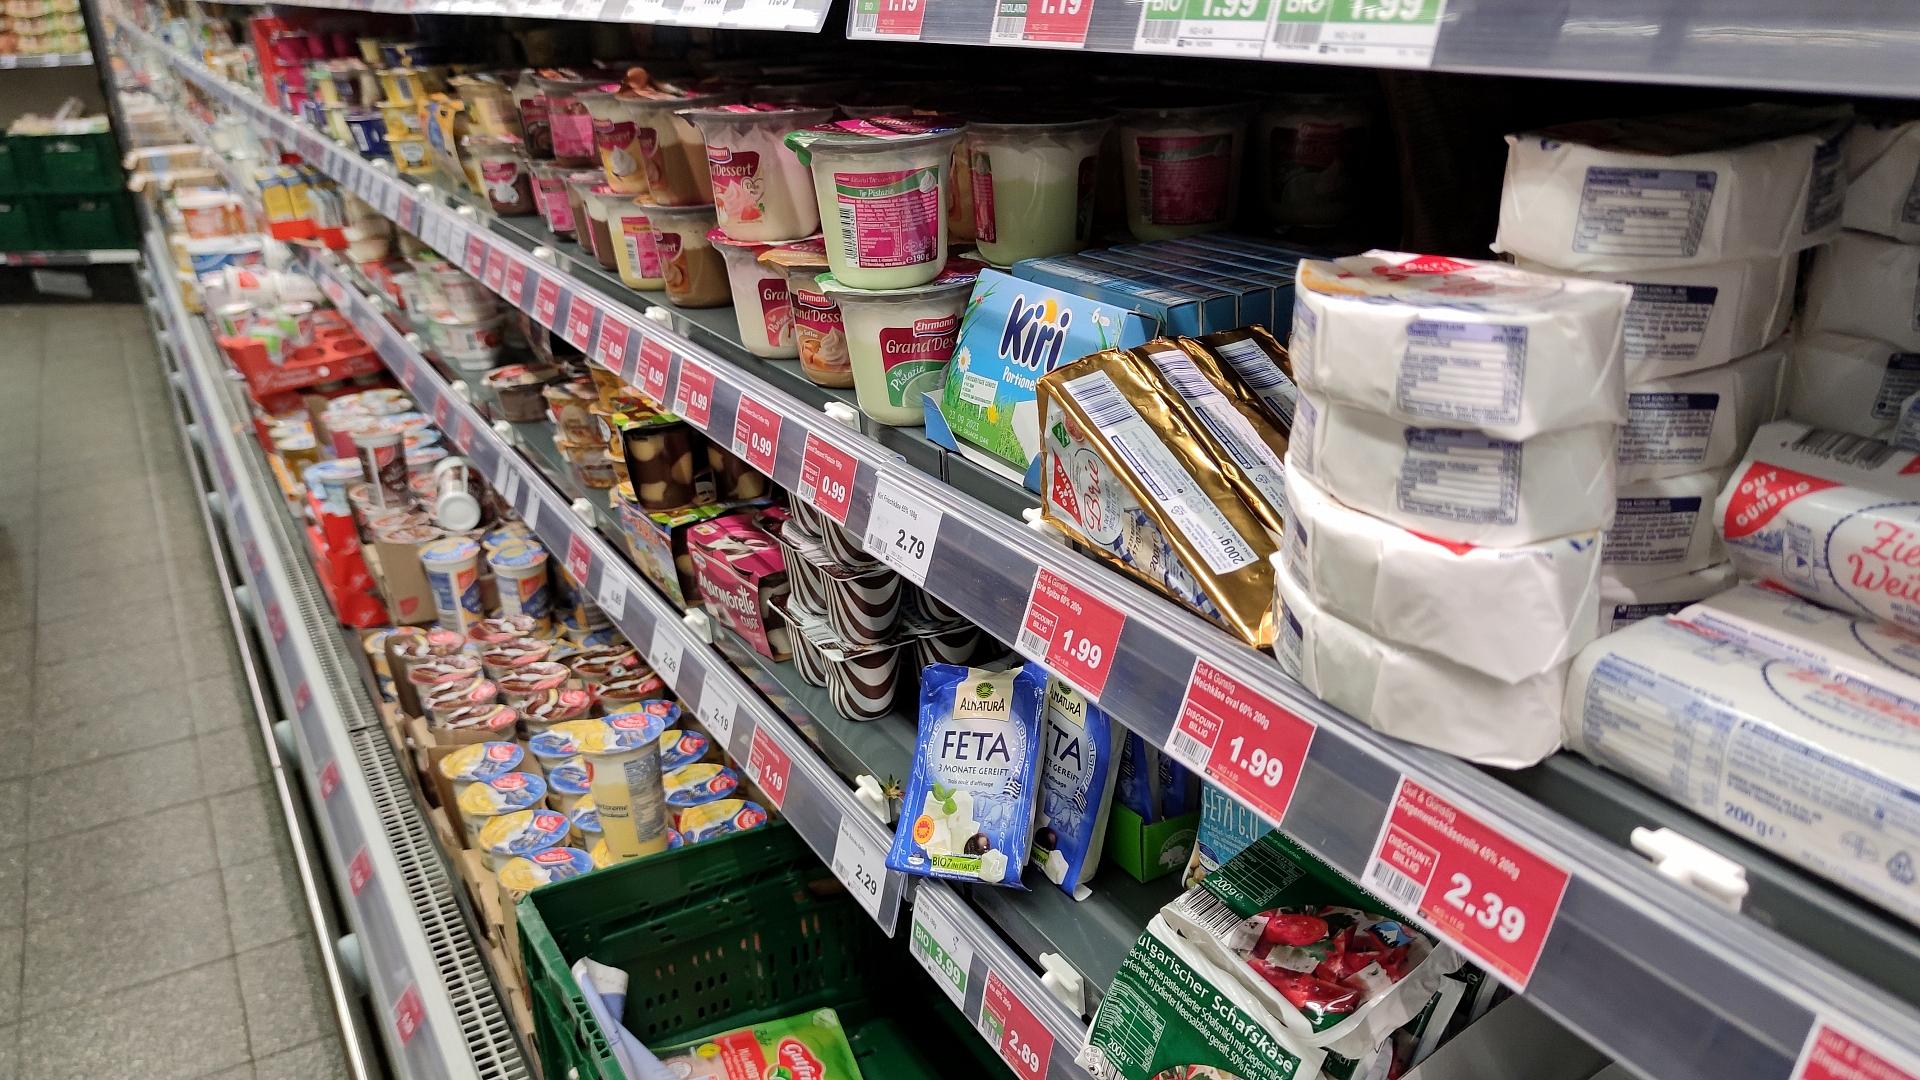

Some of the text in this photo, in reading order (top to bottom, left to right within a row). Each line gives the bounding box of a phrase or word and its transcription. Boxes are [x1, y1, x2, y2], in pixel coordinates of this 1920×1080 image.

[1000, 4, 1027, 13] BIOLAND
[800, 293, 830, 303] Ehrman
[916, 319, 954, 331] Ehrmann
[1092, 307, 1101, 323] 6
[886, 340, 930, 353] Grand
[1000, 296, 1071, 373] Kiri
[650, 367, 664, 387] 0.99
[891, 365, 926, 392] Pistazie
[691, 390, 707, 411] 0.99
[966, 418, 979, 431] 2023
[752, 433, 771, 456] 0.99
[822, 476, 846, 503] 0.99
[1741, 471, 1776, 494] GUT
[1056, 484, 1068, 507] GUT
[1084, 459, 1101, 532] Brie
[1736, 481, 1810, 526] GÜNSTIG
[896, 529, 924, 559] 2.79
[1040, 570, 1048, 580] Gut
[1052, 578, 1068, 594] Günstig
[1036, 581, 1046, 591] Brie
[1046, 587, 1060, 601] Spitze
[1070, 600, 1082, 616] 200g
[1031, 609, 1054, 627] DISCOUNT-
[1032, 620, 1047, 634] BILLIG
[1063, 629, 1102, 669] 1.99
[1198, 663, 1207, 674] Gut
[1214, 674, 1236, 695] Günstig
[960, 698, 1005, 712] ALNATURA
[1194, 676, 1270, 730] Weichkäse oval 60% 200g
[714, 708, 729, 730] 2.19
[1186, 707, 1217, 731] DISCOUNT-
[1188, 720, 1208, 738] BILLIG
[941, 731, 1010, 762] FETA
[944, 765, 976, 774] MONATE
[1053, 764, 1079, 784] GEREIFT
[1230, 736, 1284, 787] 1.99
[765, 765, 782, 790] 1.19
[1204, 786, 1233, 831] FETA
[1403, 782, 1418, 800] Gut
[1426, 794, 1457, 824] Günstig
[1725, 801, 1766, 836] 200 g
[1388, 833, 1432, 867] DISCOUNT-
[1398, 796, 1479, 854] Ziegenweichkäserolle
[1498, 856, 1520, 881] 200g
[932, 856, 980, 871] BIO7 INITIATIVE
[1392, 850, 1420, 874] BILLIG
[856, 864, 877, 896] 2.29
[1213, 876, 1236, 896] 200g
[1443, 872, 1525, 943] 2.39
[915, 926, 960, 985] BIO 3.99
[1130, 947, 1158, 976] eichkäse
[1153, 964, 1165, 980] aus
[1163, 972, 1201, 1013] pasteurisierter
[1199, 1008, 1235, 1044] Schafsmilch
[1233, 1037, 1246, 1053] mit
[1138, 935, 1209, 998] ulgarischer
[1211, 995, 1294, 1072] Schafskäse
[1123, 957, 1148, 981] erfeinert,
[1152, 980, 1176, 1006] jodierter
[1175, 1002, 1210, 1036] Meersalzlake
[1208, 1032, 1229, 1054] gereift.
[1229, 1051, 1245, 1069] 50%
[1242, 1061, 1256, 1080] Fett
[1009, 1030, 1039, 1072] 2.89
[1107, 1037, 1127, 1061] 200g
